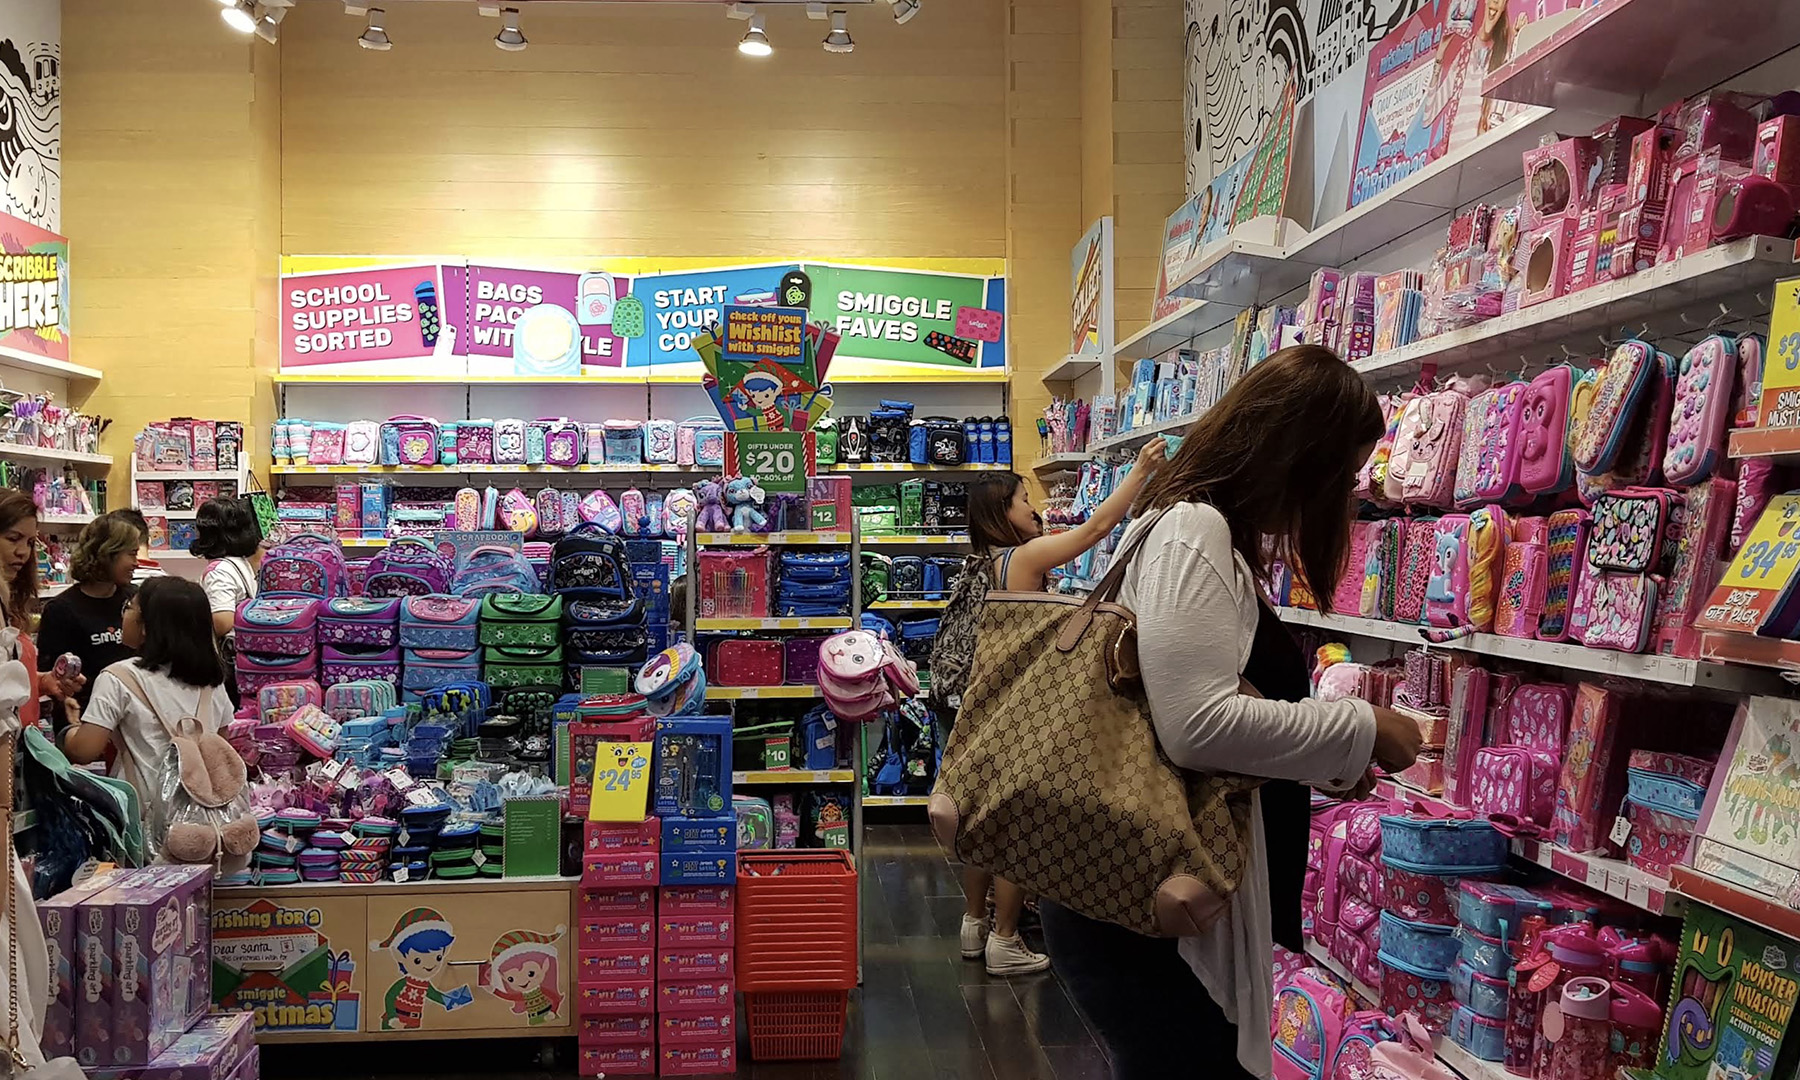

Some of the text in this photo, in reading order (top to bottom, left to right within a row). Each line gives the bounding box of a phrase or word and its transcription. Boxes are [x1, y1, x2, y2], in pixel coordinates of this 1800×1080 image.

[290, 283, 391, 308] SCHOOL
[477, 281, 543, 304] BAGS
[655, 285, 728, 308] START
[0, 280, 59, 329] HERE
[475, 303, 523, 325] PAC
[836, 291, 952, 320] SMIGGLE
[292, 303, 413, 332] SUPPLIES
[656, 308, 719, 331] YOUR
[729, 311, 758, 321] check
[760, 312, 776, 323] off
[473, 326, 514, 347] WIT
[728, 323, 802, 343] Wishlist
[836, 315, 919, 342] FAVES
[294, 328, 392, 354] SORTED
[728, 341, 801, 357] with smiggle
[1767, 409, 1795, 427] MUST
[745, 451, 795, 473] $20
[782, 474, 795, 482] off
[812, 511, 833, 522] $12
[456, 533, 510, 542] SCRAPBOOK
[91, 627, 124, 645] smig
[766, 750, 787, 761] $10
[826, 833, 846, 846] $15
[308, 910, 320, 924] a
[213, 945, 237, 955] Dear
[1740, 959, 1798, 1002] MONSTER
[237, 987, 287, 1000] smiggle
[1733, 981, 1791, 1026] INVASION
[211, 1002, 335, 1027] stmas
[1729, 1015, 1777, 1048] ACTIVITY BOOK!
